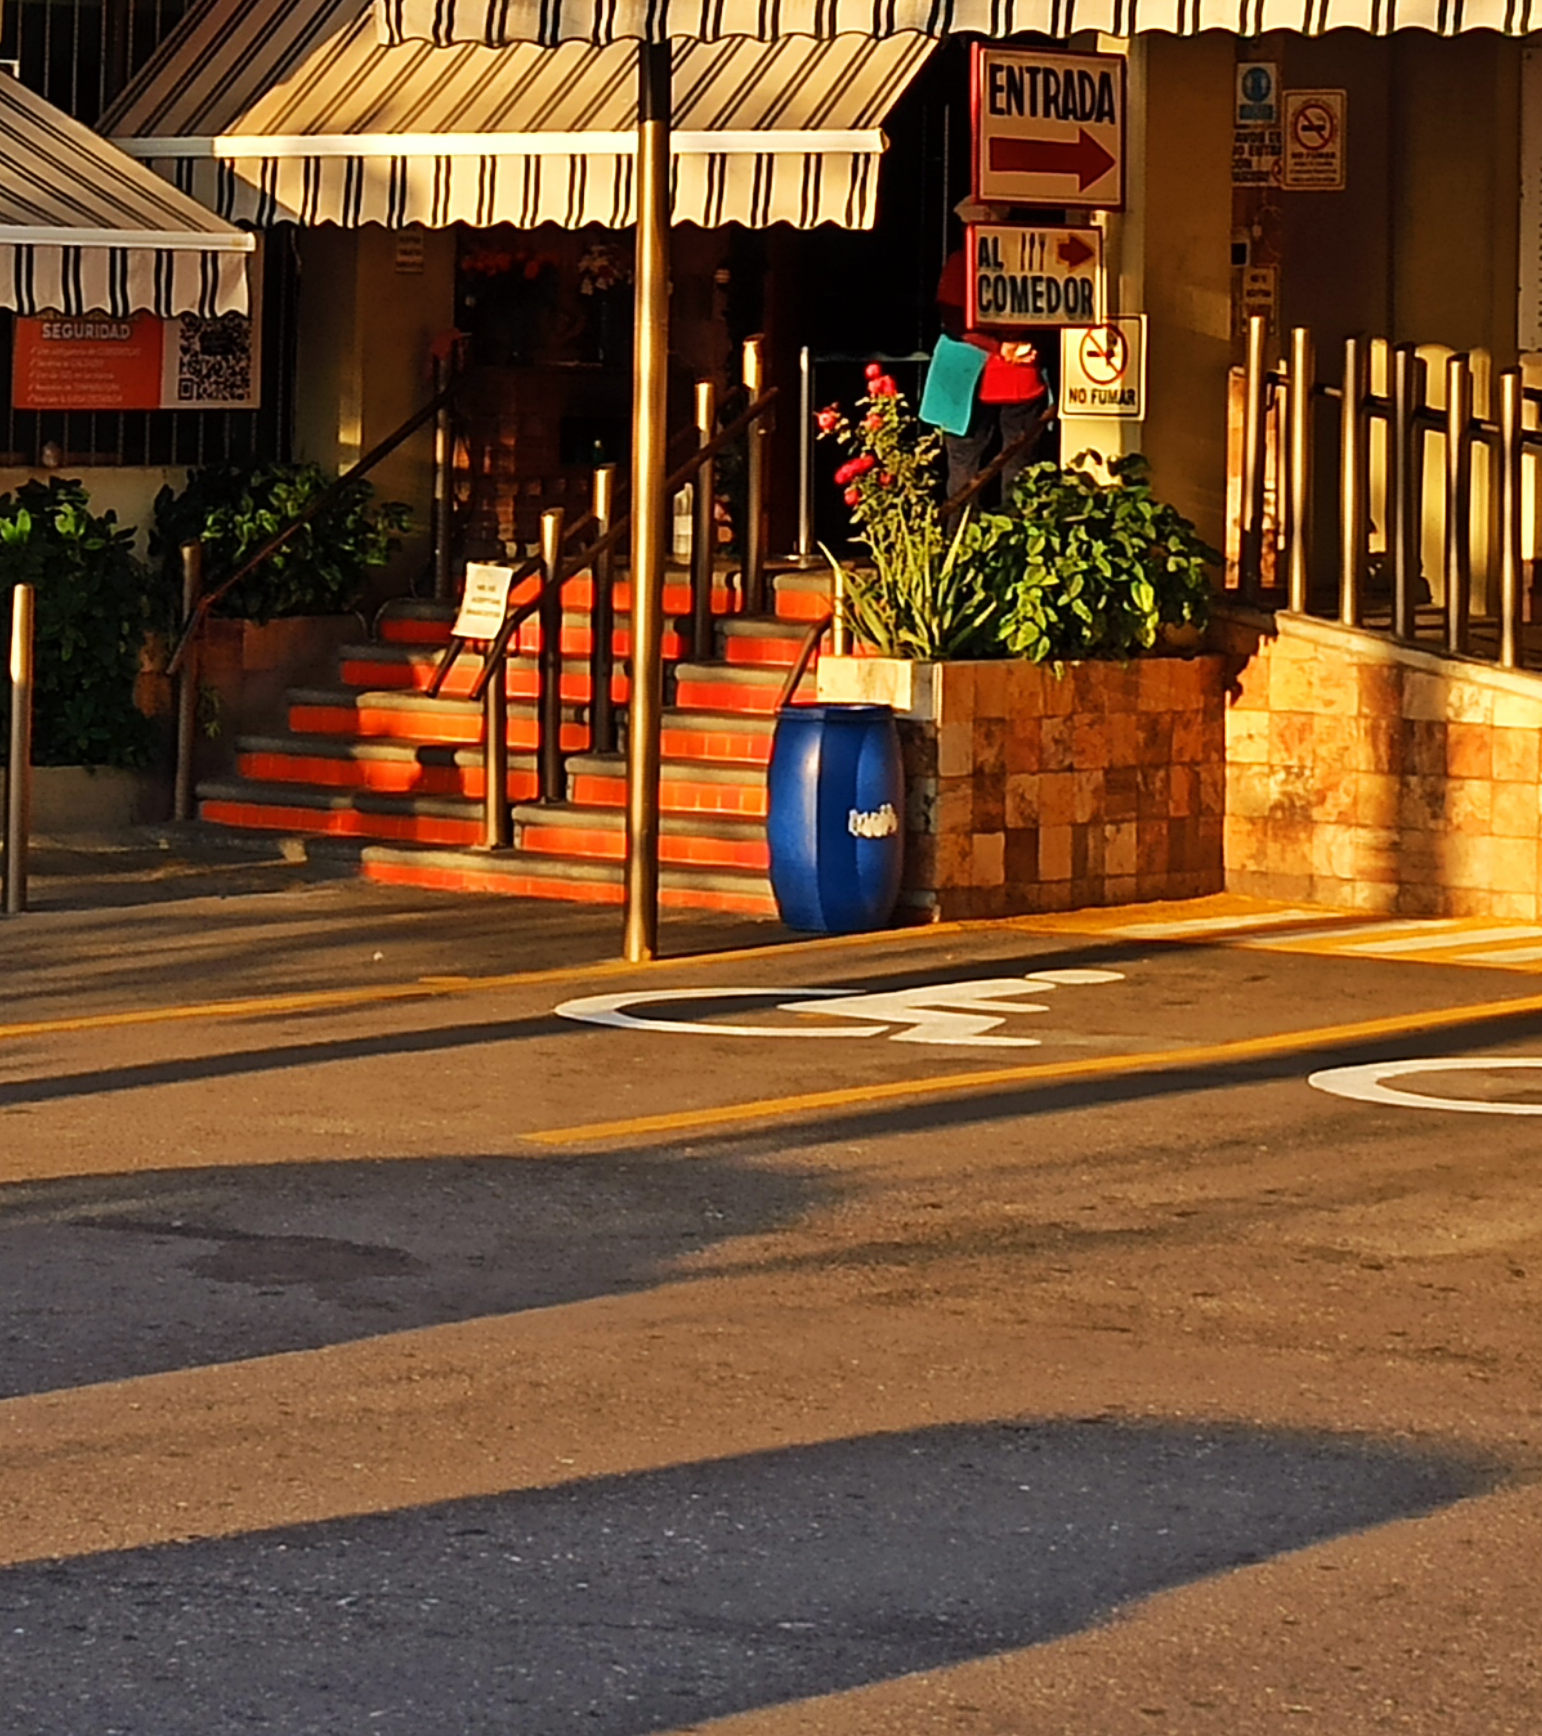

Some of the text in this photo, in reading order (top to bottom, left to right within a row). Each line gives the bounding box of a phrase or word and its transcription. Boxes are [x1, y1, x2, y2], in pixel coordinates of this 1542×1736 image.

[988, 62, 1116, 125] ENTRADA
[977, 235, 1004, 270] AL
[977, 273, 1094, 315] COMEDOR
[41, 322, 131, 341] SEGURIDAD
[1068, 387, 1136, 406] NO FUMAR
